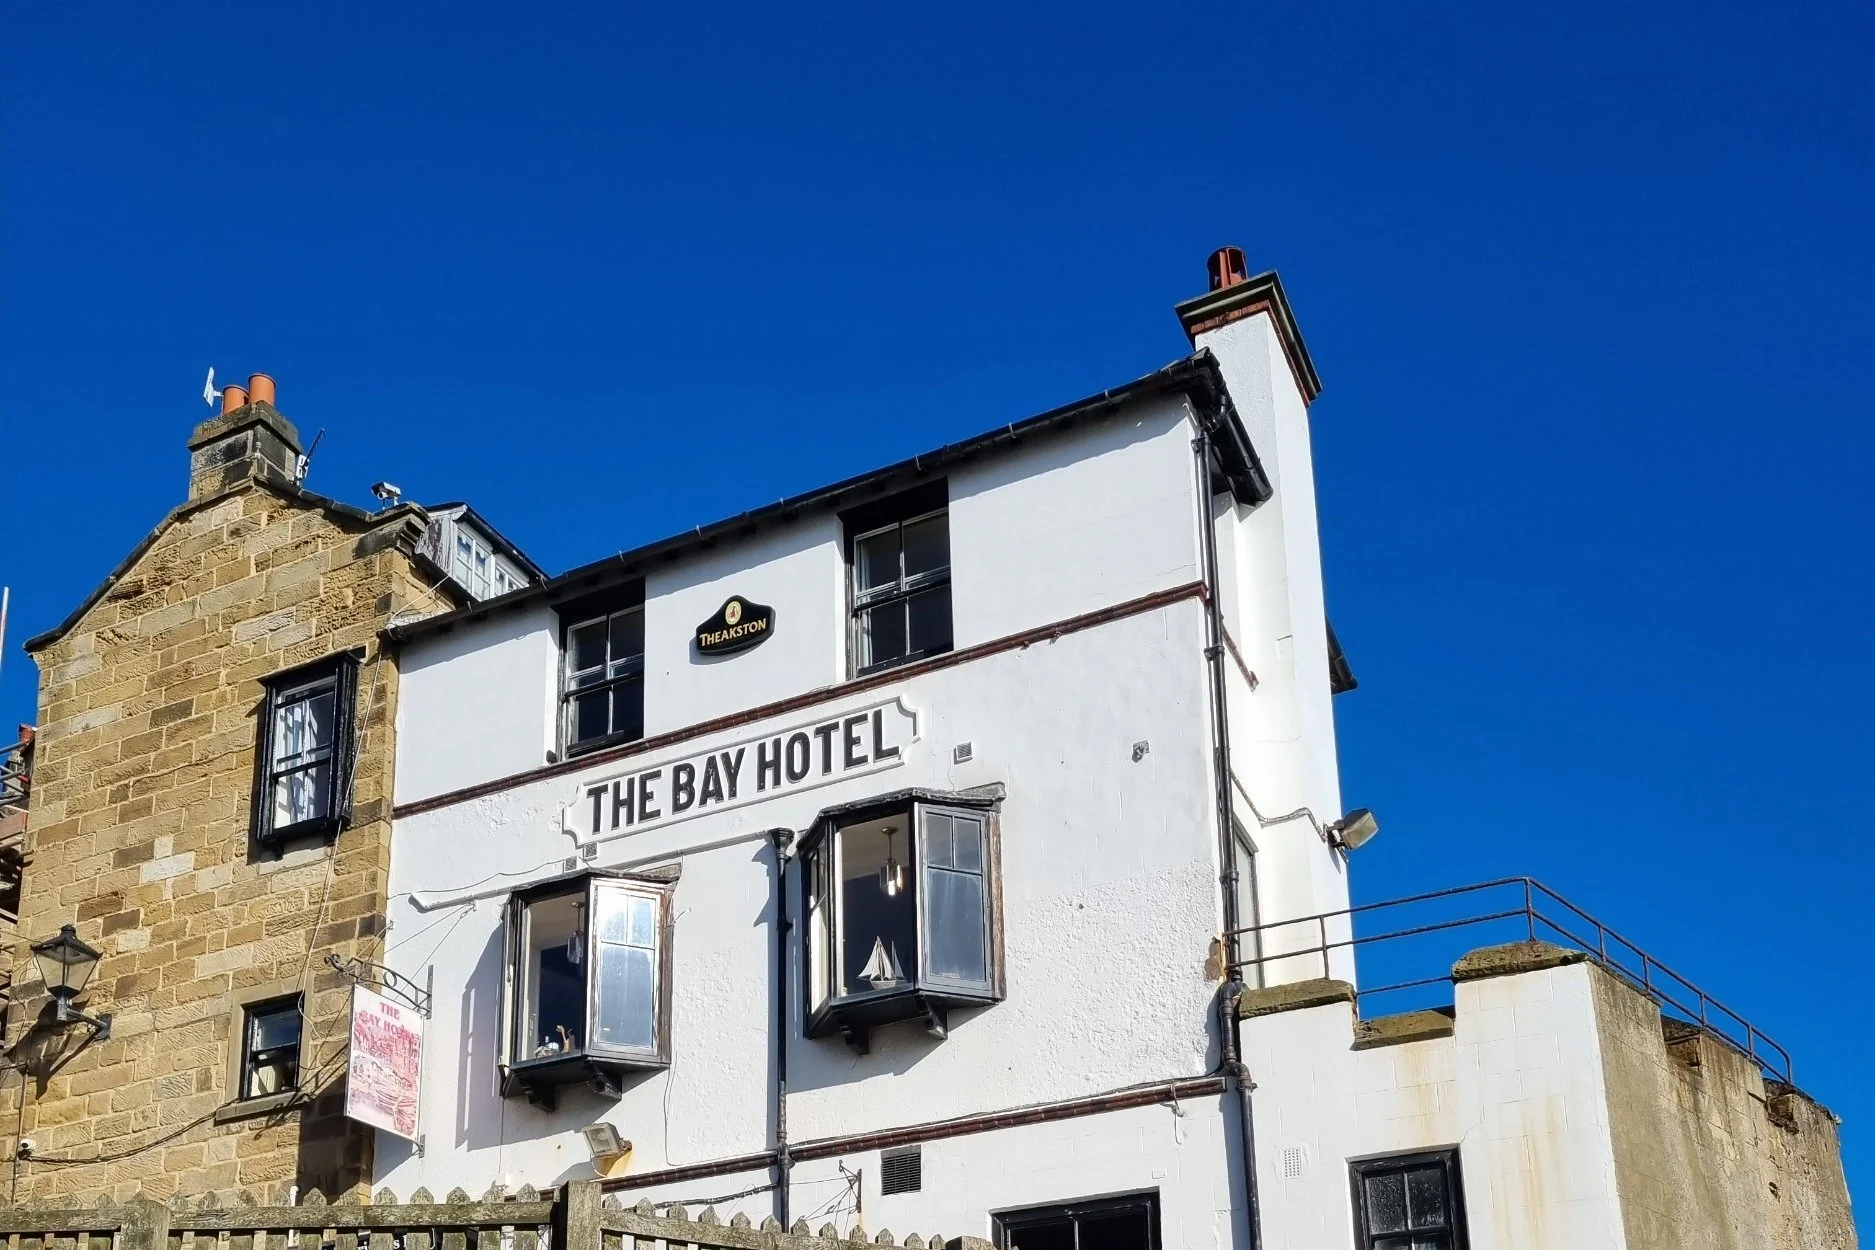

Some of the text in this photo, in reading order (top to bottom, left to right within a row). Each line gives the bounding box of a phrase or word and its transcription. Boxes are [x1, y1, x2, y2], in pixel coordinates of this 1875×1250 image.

[700, 618, 767, 646] THEAKSTON
[587, 708, 900, 835] THE BAY HOTEL
[380, 1002, 400, 1020] THE
